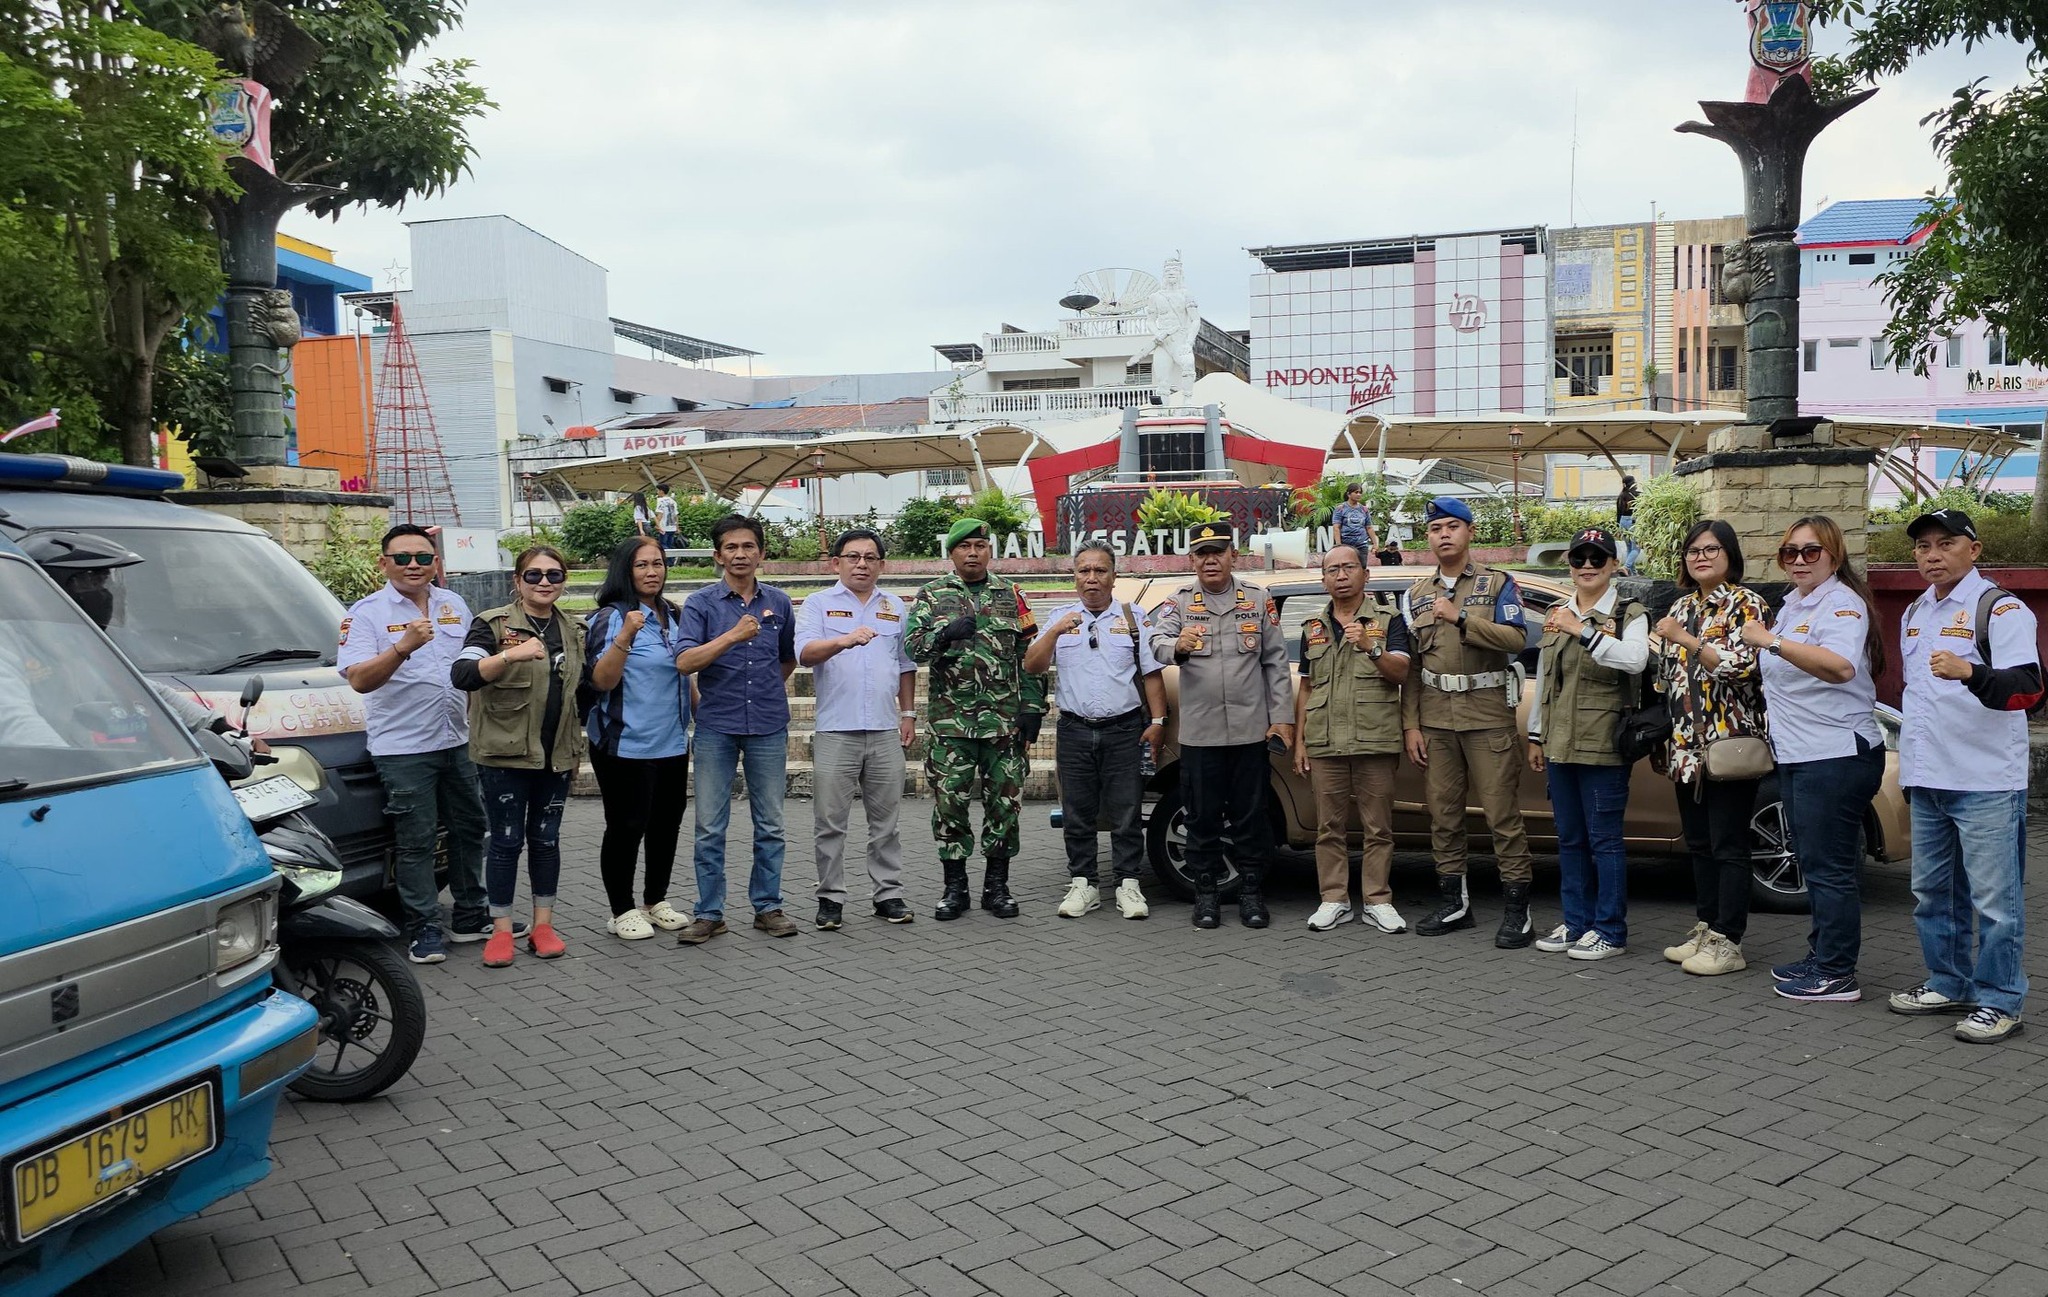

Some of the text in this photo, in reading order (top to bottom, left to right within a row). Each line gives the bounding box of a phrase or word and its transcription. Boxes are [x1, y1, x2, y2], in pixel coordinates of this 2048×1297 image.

[1265, 364, 1398, 387] INDONESIA
[1988, 369, 2022, 391] PARIS
[1350, 377, 1393, 406] Indah
[623, 435, 687, 450] APOTIK
[1186, 614, 1210, 622] TOMMY
[1235, 612, 1260, 620] POLRI
[1503, 604, 1519, 620] P
[290, 692, 352, 708] CALL
[280, 710, 364, 731] CENTE
[22, 1092, 199, 1209] DB 1679 RK
